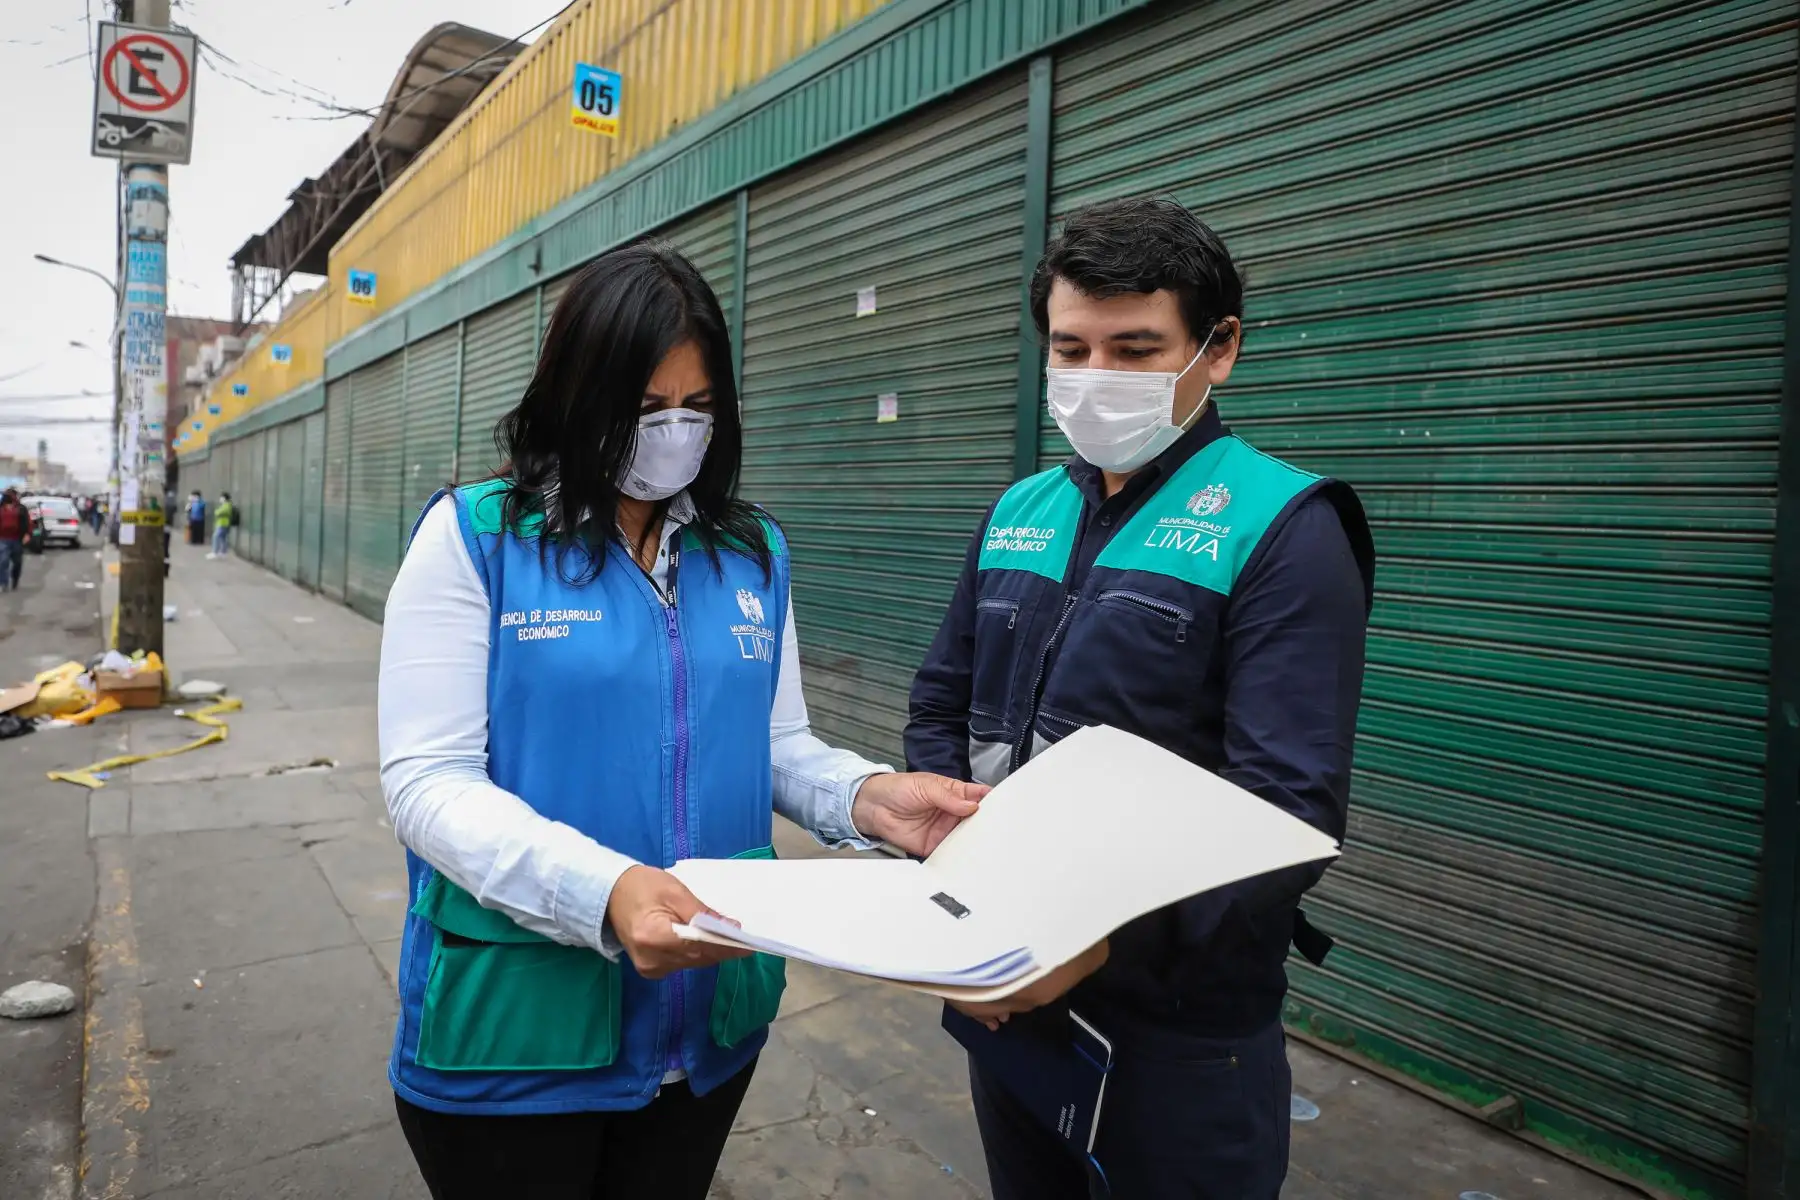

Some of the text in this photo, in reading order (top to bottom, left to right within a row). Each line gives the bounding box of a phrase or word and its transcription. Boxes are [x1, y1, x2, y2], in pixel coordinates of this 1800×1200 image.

[581, 79, 613, 116] 05
[352, 278, 372, 296] 06
[1159, 517, 1222, 533] MUNICIPALIDAD
[1143, 528, 1219, 562] LIMA
[530, 610, 542, 623] DE
[545, 610, 602, 622] DESARROLLO
[518, 621, 569, 641] ECONÓMICO
